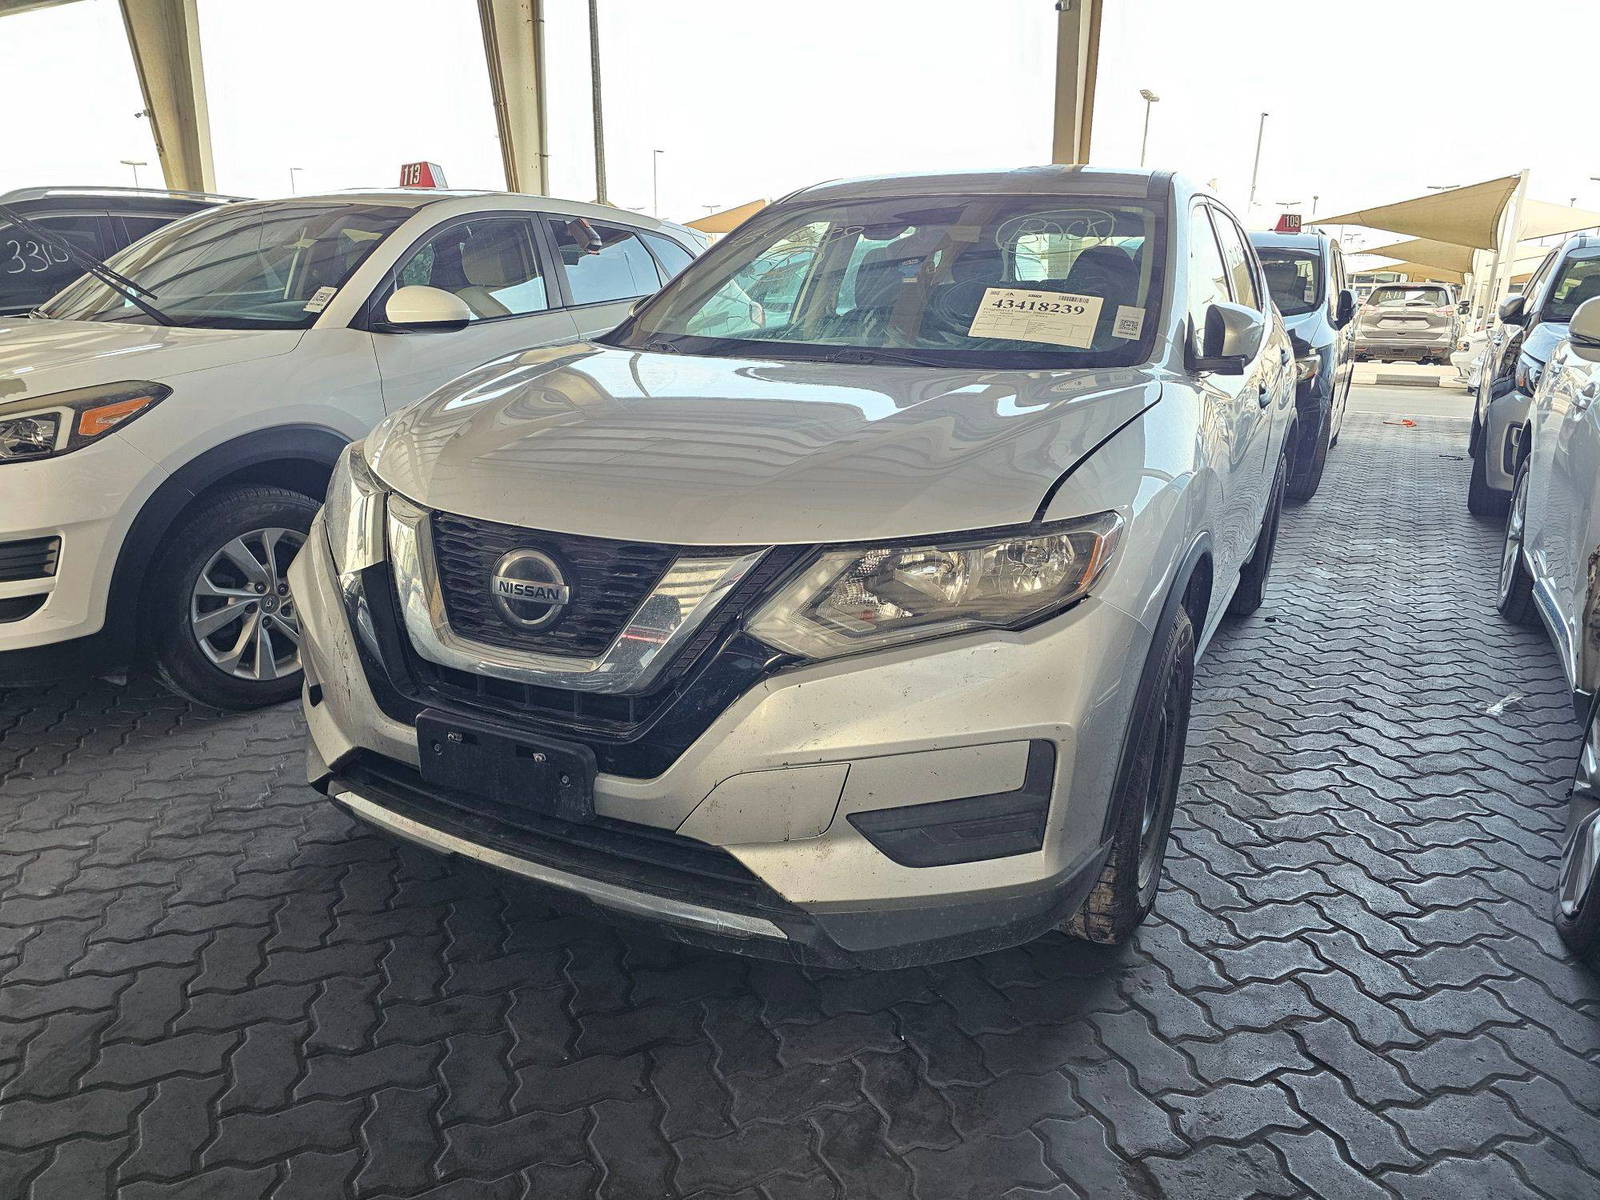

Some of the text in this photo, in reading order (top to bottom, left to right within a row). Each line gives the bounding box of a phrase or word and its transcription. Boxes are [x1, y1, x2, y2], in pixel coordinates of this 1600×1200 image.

[403, 164, 420, 185] 113
[1286, 215, 1300, 227] 109
[992, 299, 1085, 316] 43418239
[499, 580, 559, 600] NISSAN
